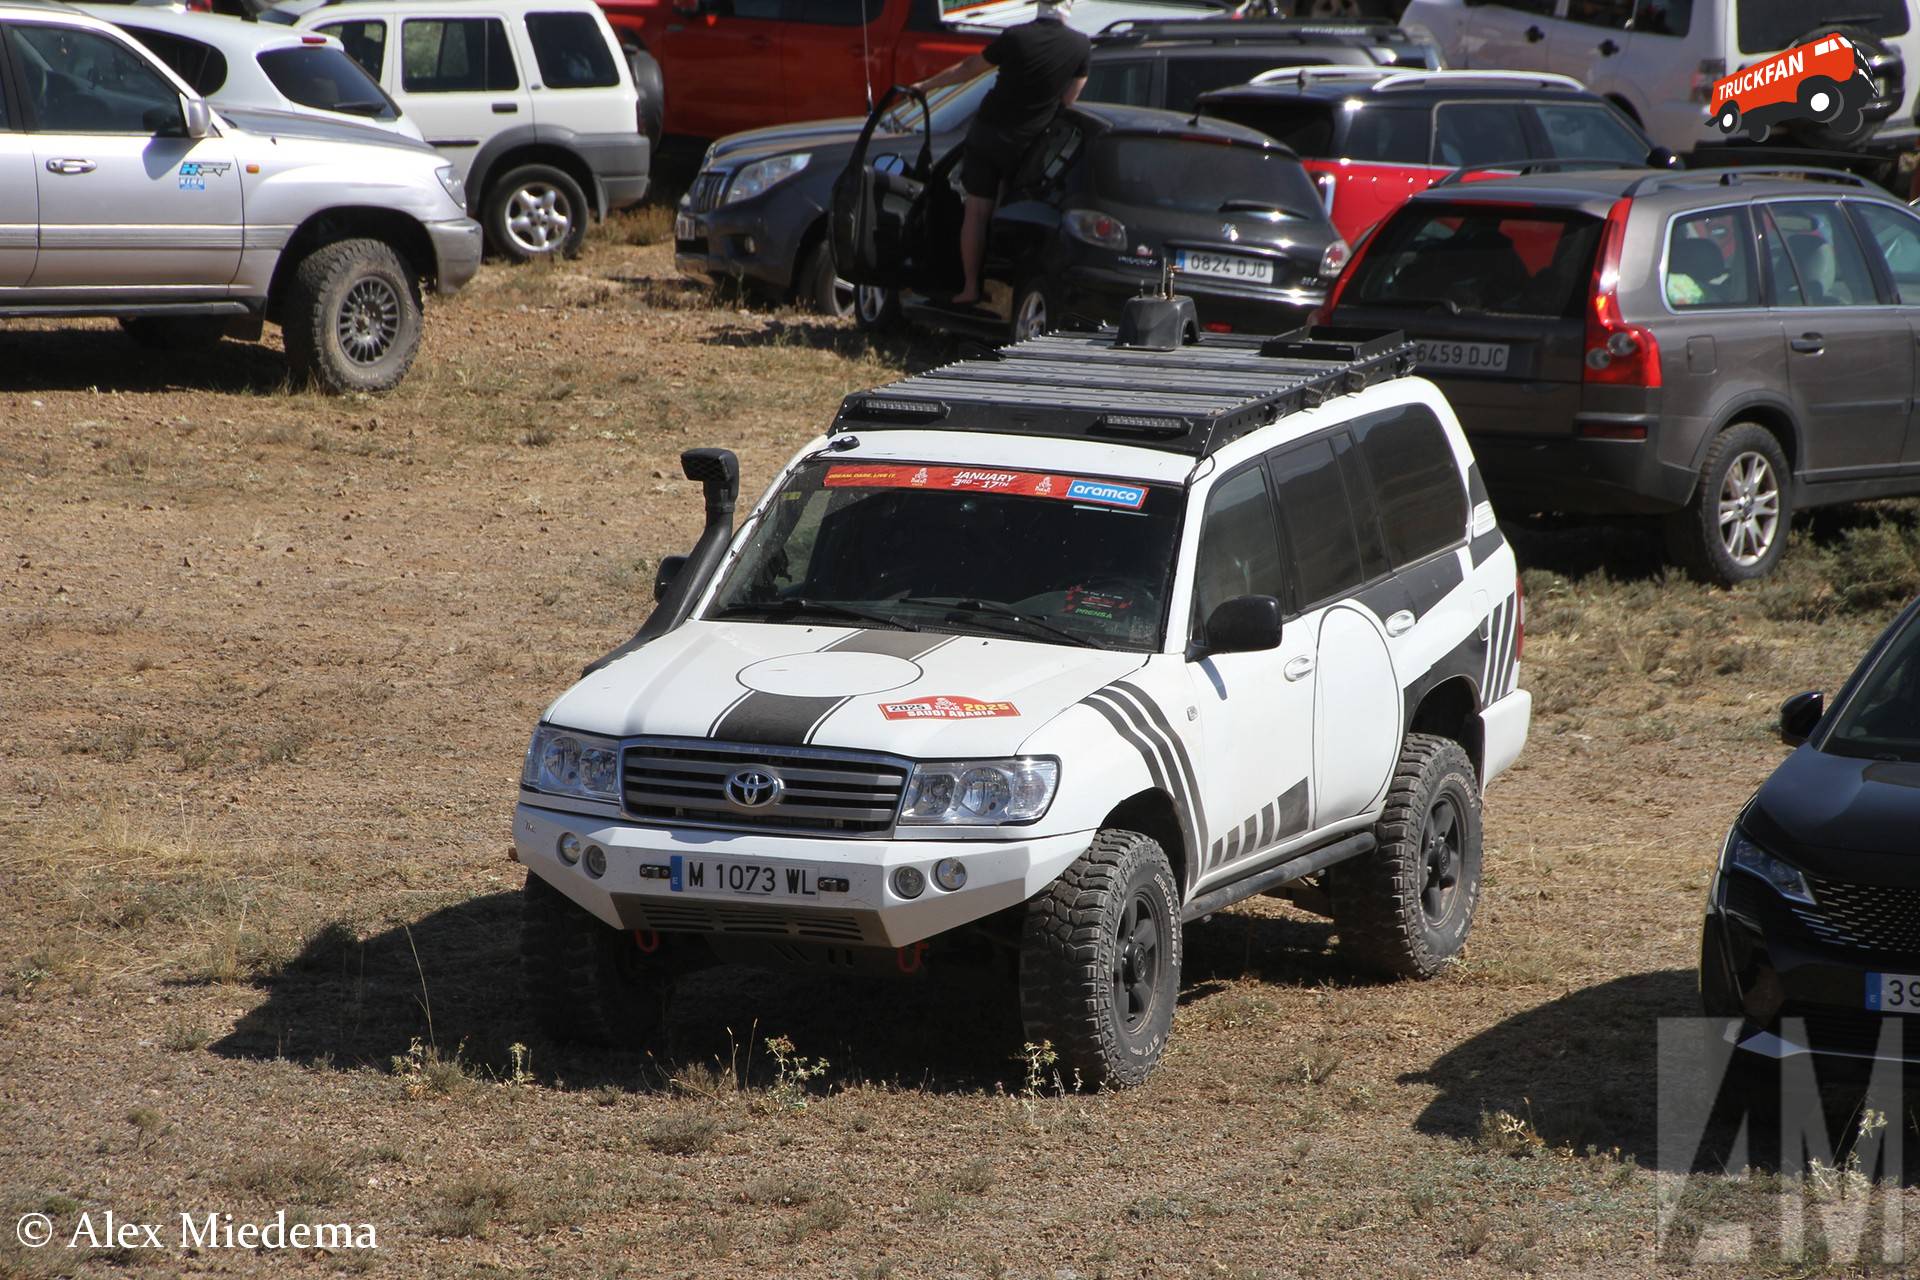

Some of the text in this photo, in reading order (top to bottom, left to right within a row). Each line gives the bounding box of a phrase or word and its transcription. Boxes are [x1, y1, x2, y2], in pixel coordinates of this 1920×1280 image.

[1190, 254, 1268, 280] 0824 DJD
[1416, 343, 1505, 367] 6459 DJC
[953, 471, 1017, 482] JANUARY
[1073, 485, 1137, 501] aramco
[906, 710, 996, 718] SAUDI ARABIA
[963, 703, 1010, 712] 2025
[688, 861, 817, 896] M 1073 WL
[1153, 873, 1178, 967] DISCOVERER
